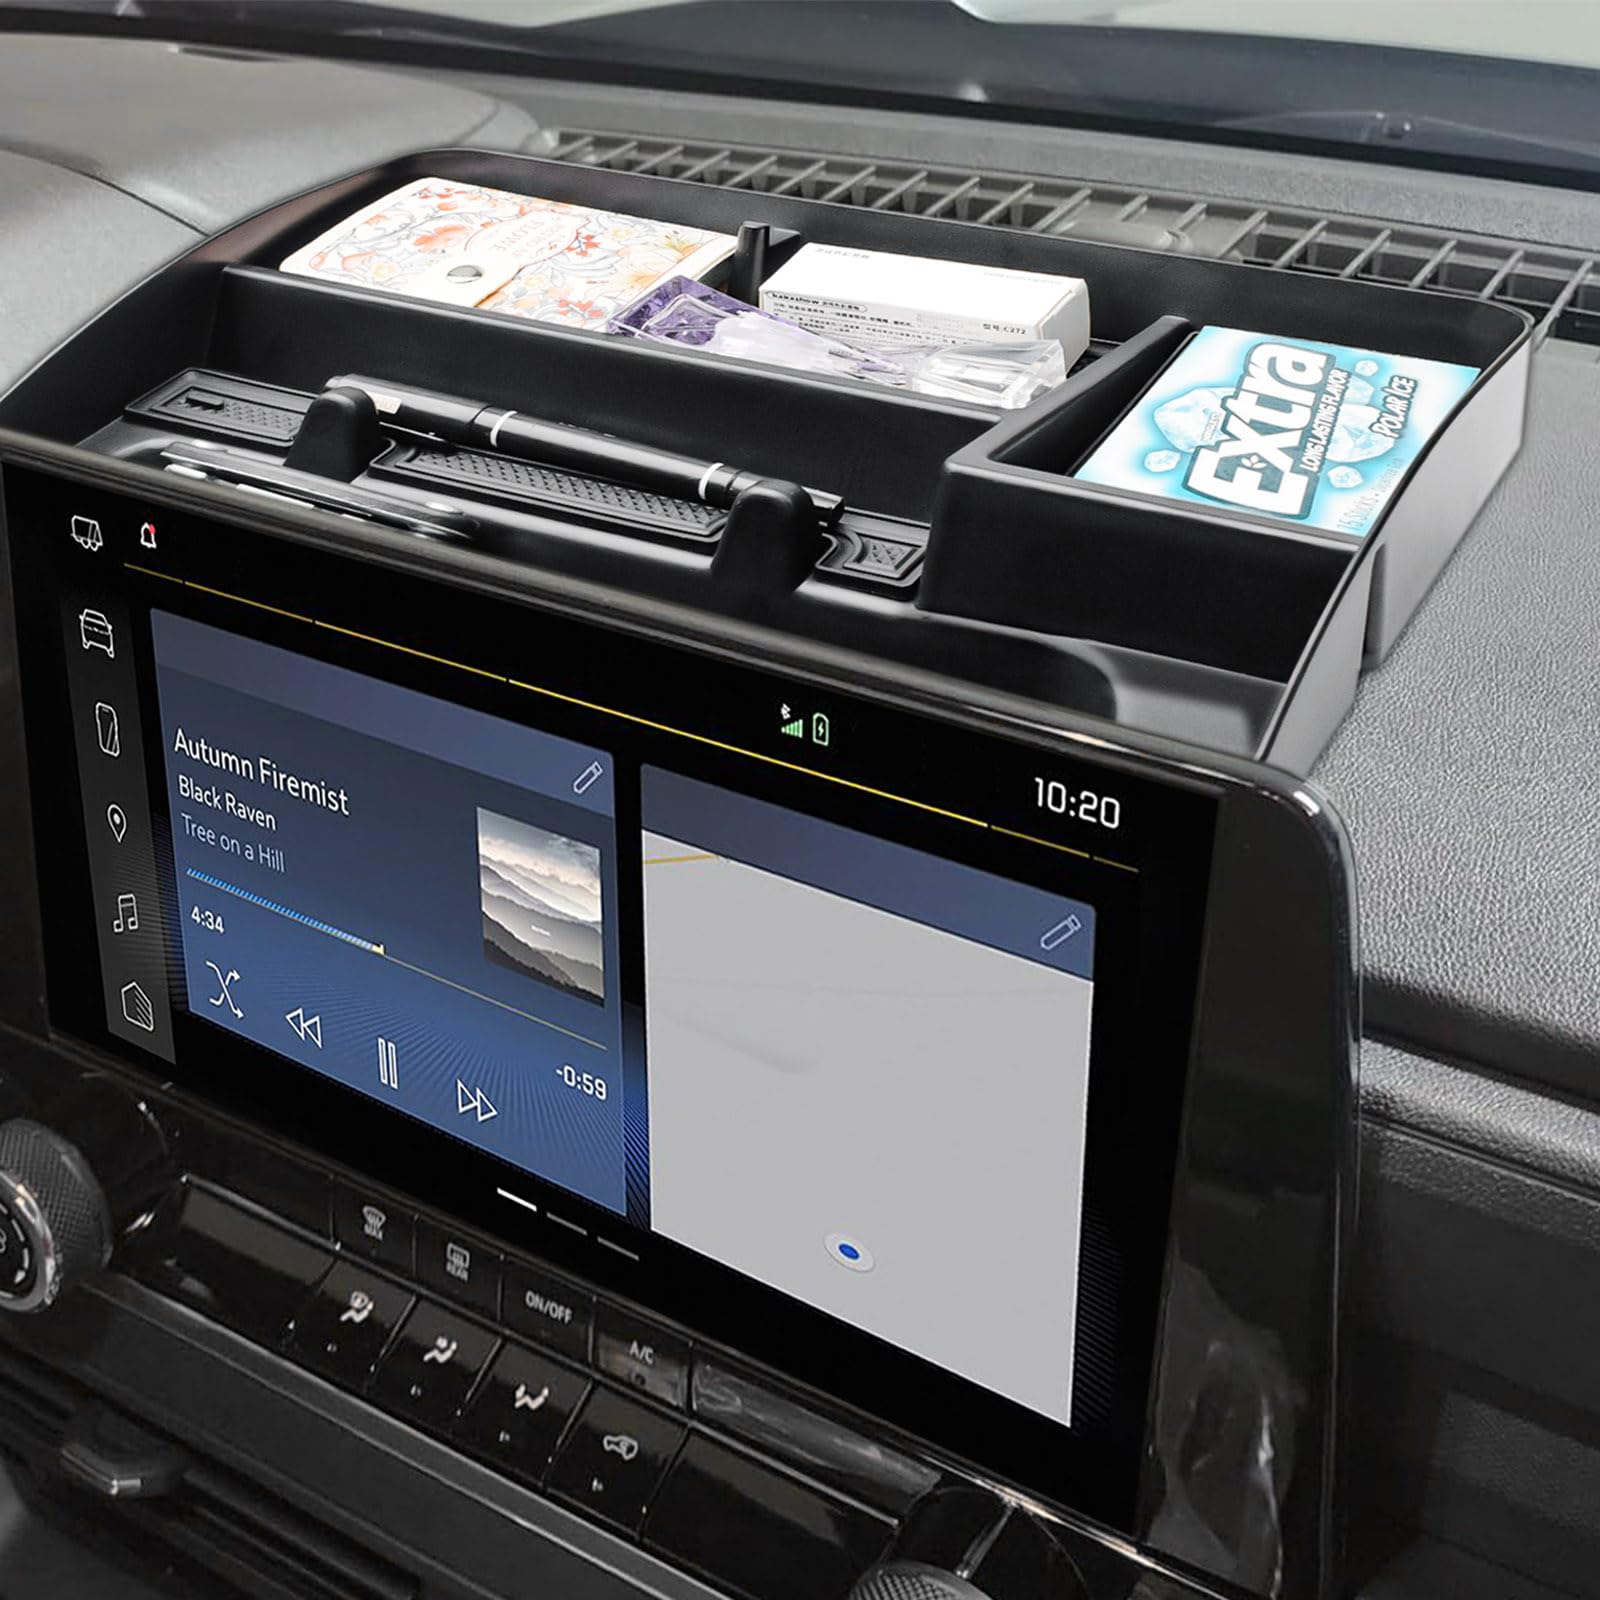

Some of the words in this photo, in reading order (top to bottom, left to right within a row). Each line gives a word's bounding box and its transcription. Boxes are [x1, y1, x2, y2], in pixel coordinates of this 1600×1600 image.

[1321, 368, 1349, 406] FLAVOR
[1383, 375, 1416, 399] ICE
[1186, 342, 1329, 516] Extra
[1308, 399, 1339, 446] LASTING
[1370, 396, 1410, 438] POLAR
[1299, 439, 1325, 473] LONG
[174, 728, 254, 780] Autumn
[259, 757, 349, 816] Firemist
[178, 774, 222, 811] Black
[225, 793, 276, 831] Raven
[1035, 777, 1120, 829] 10:20
[181, 812, 216, 846] Tree
[220, 835, 241, 855] on
[244, 845, 254, 861] a
[259, 843, 285, 873] Hill
[191, 906, 225, 934] 4:34
[556, 1065, 606, 1100] -0:59
[446, 1261, 468, 1282] REAR
[525, 1290, 572, 1324] ON/OFF
[629, 1340, 654, 1365] A/C
